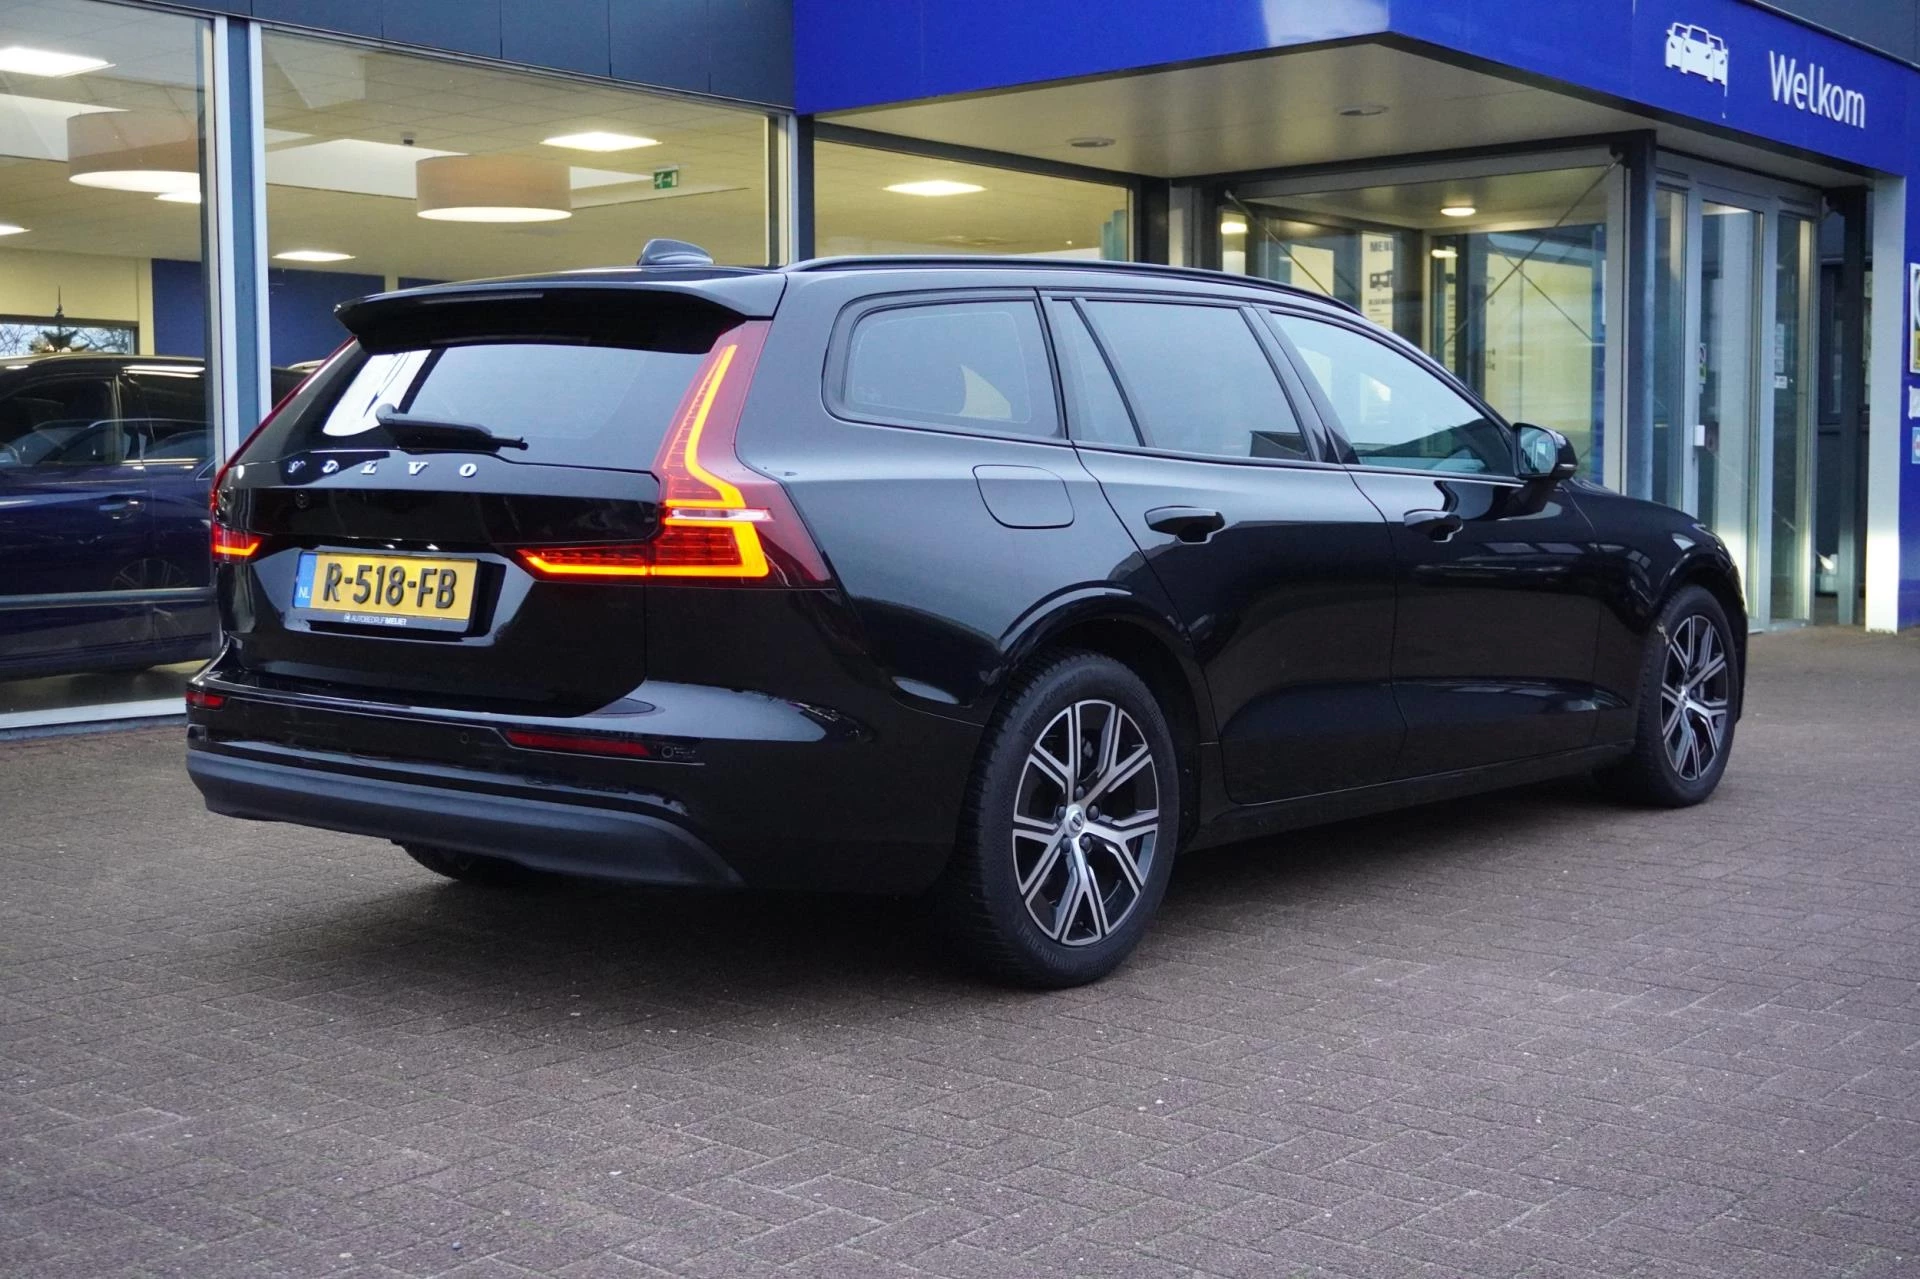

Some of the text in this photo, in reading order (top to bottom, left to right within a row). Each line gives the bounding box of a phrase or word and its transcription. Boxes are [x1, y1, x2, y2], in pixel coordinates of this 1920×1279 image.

[1770, 50, 1865, 128] Welkom
[288, 460, 477, 477] VOLVO
[299, 586, 310, 599] NL
[323, 562, 457, 609] R-518-FB
